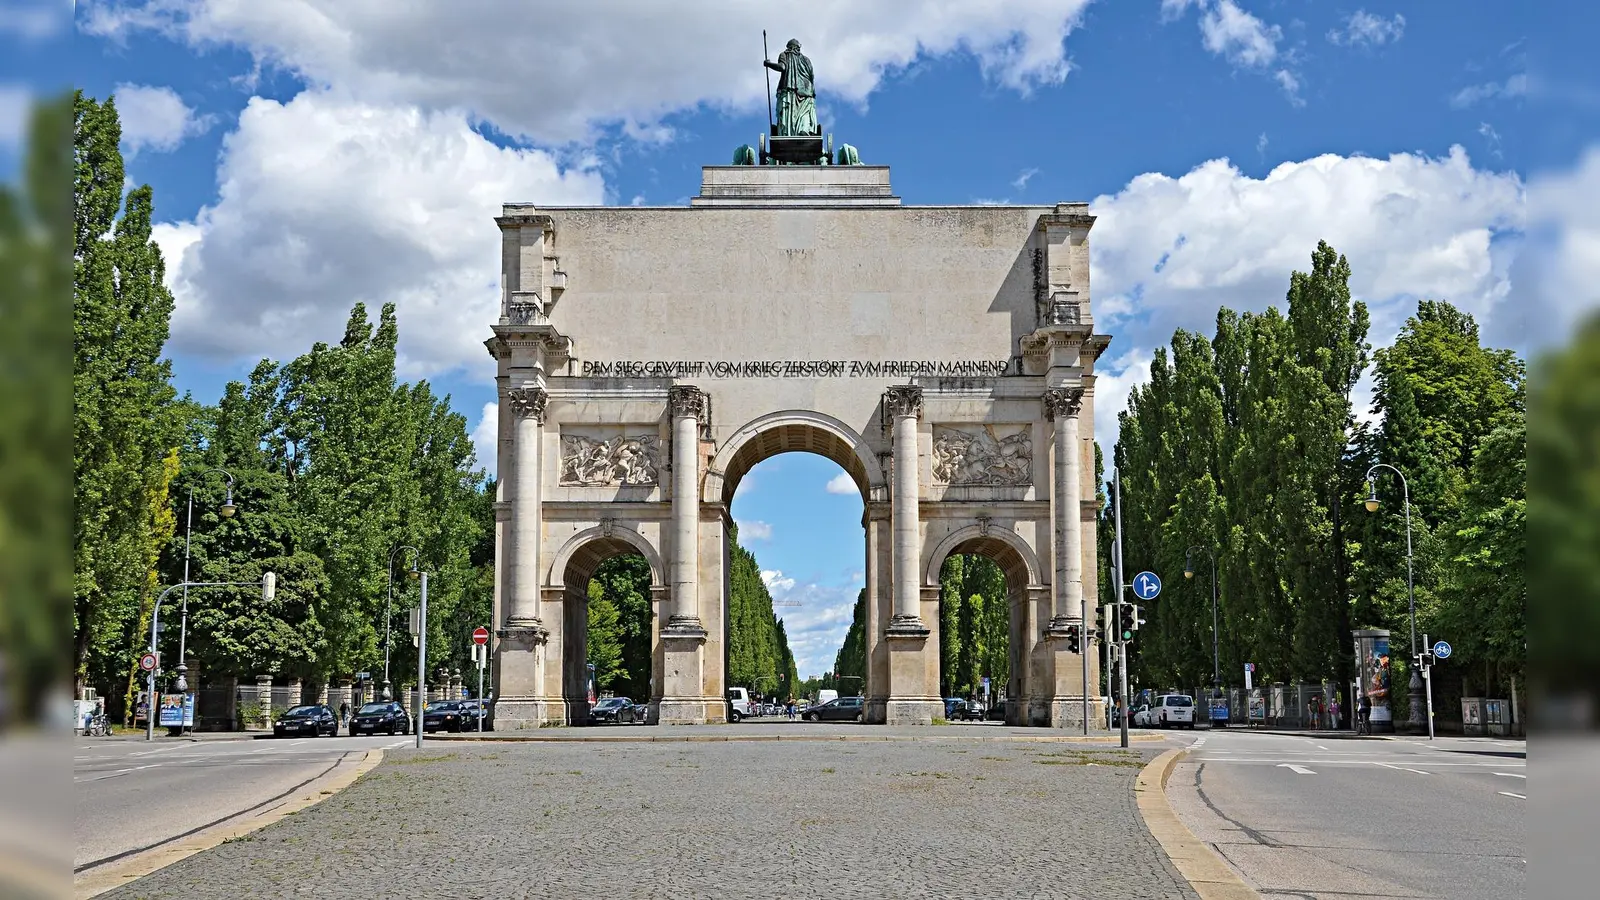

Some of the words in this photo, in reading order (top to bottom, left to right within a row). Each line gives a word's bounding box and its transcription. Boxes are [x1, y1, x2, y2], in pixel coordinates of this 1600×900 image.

[583, 361, 613, 373] DEM
[615, 361, 643, 373] SIEG
[645, 361, 705, 373] GEWEIHT
[708, 361, 742, 373] VOM
[745, 361, 782, 373] KRIEG
[784, 359, 847, 373] ZERSTÖRT
[850, 361, 881, 373] ZVM
[884, 361, 936, 373] FRIEDEN
[939, 361, 1009, 373] MAHNEND
